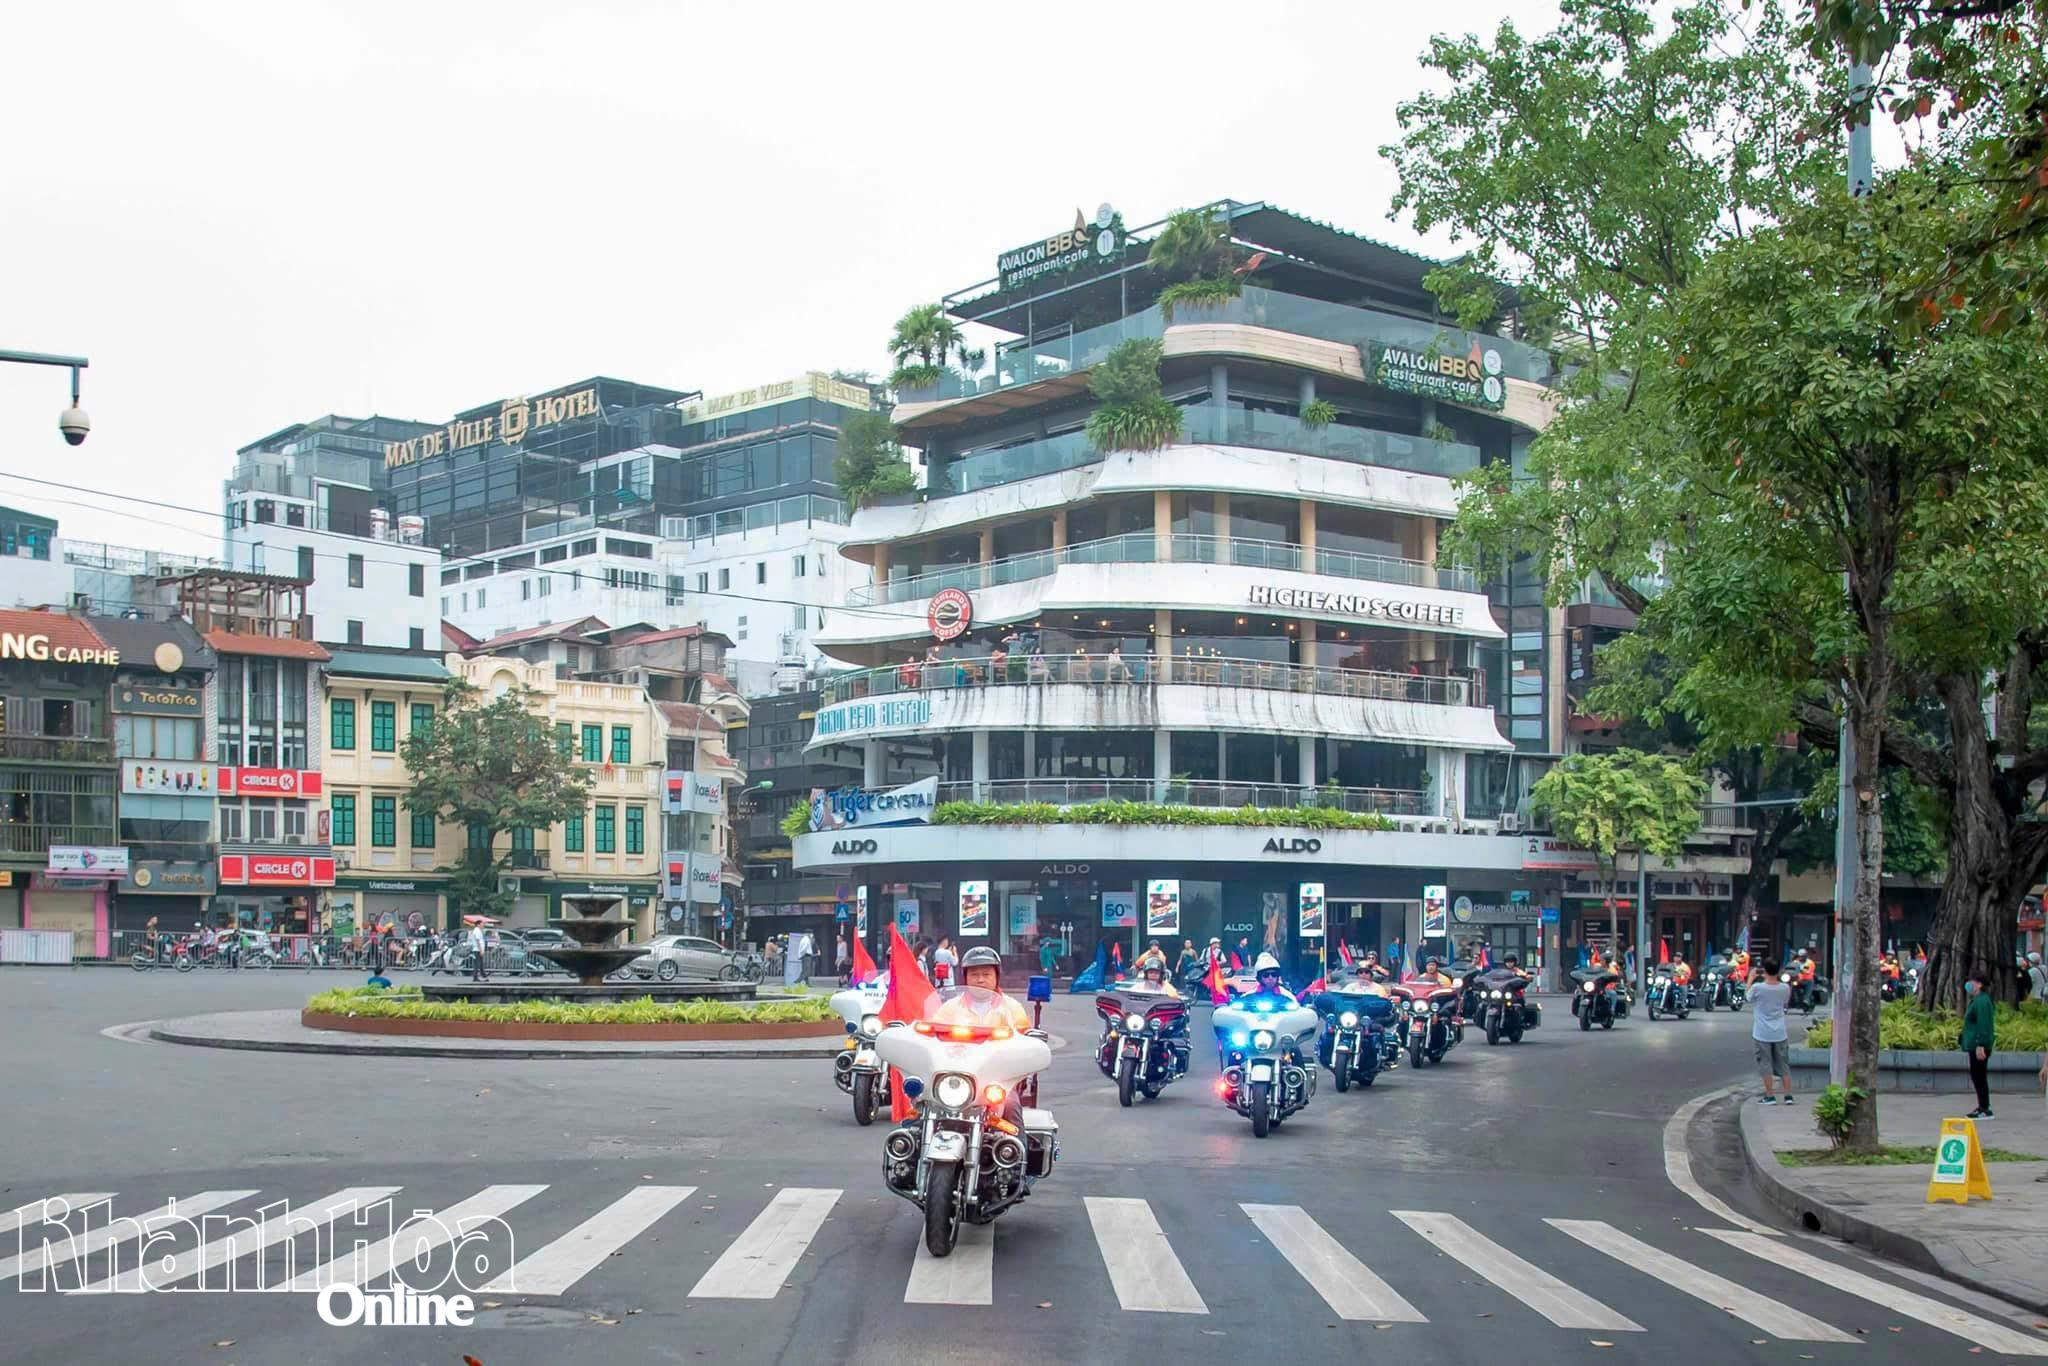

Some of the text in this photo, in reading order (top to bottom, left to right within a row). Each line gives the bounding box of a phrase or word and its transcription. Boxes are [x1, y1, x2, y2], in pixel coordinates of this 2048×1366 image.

[1000, 246, 1045, 272] AVALON
[1382, 348, 1438, 373] AVALON
[384, 388, 599, 470] MAY DE VILLE HOTEL
[1249, 585, 1463, 625] HIGHLANDS COFFEE
[0, 632, 49, 661] NG
[880, 699, 930, 726] BISTRO
[242, 775, 278, 787] CIRCLE
[828, 786, 934, 822] Tiger CRYSTAL
[831, 839, 878, 855] ALDO
[1262, 837, 1322, 853] ALDO
[254, 863, 290, 875] CIRCLE
[1040, 863, 1091, 875] ALDO
[631, 897, 647, 905] ATM
[1104, 903, 1133, 917] 50%
[1223, 923, 1254, 932] ALDO
